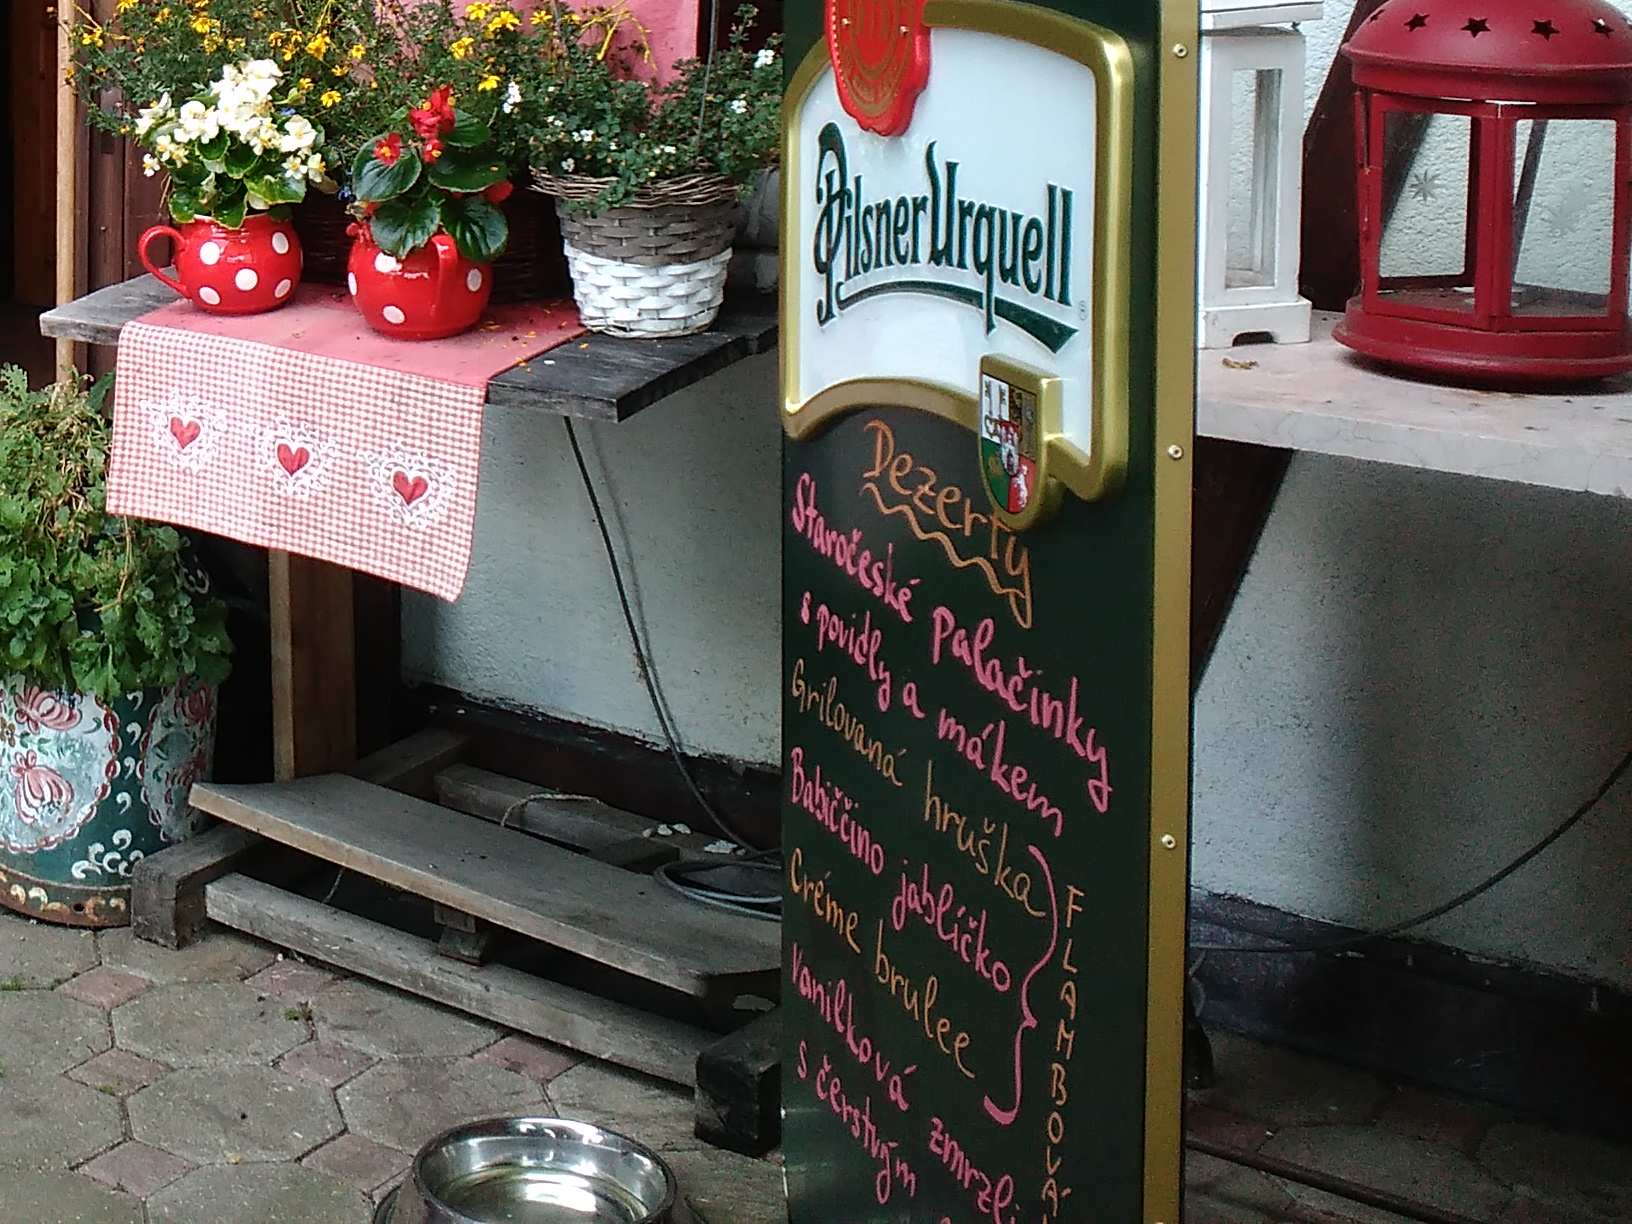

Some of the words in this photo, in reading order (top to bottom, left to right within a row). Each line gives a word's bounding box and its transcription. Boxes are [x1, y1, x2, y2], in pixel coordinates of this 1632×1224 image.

[814, 120, 927, 327] Pilsner
[925, 140, 1074, 336] Urquell
[862, 419, 1033, 629] Dezerty
[902, 681, 925, 719] a
[937, 707, 1064, 837] mákem
[932, 605, 1112, 813] Palačinky
[924, 760, 1046, 917] hruška
[874, 919, 976, 1078] brulee
[1041, 884, 1085, 1224] FLAMBOVÁ
